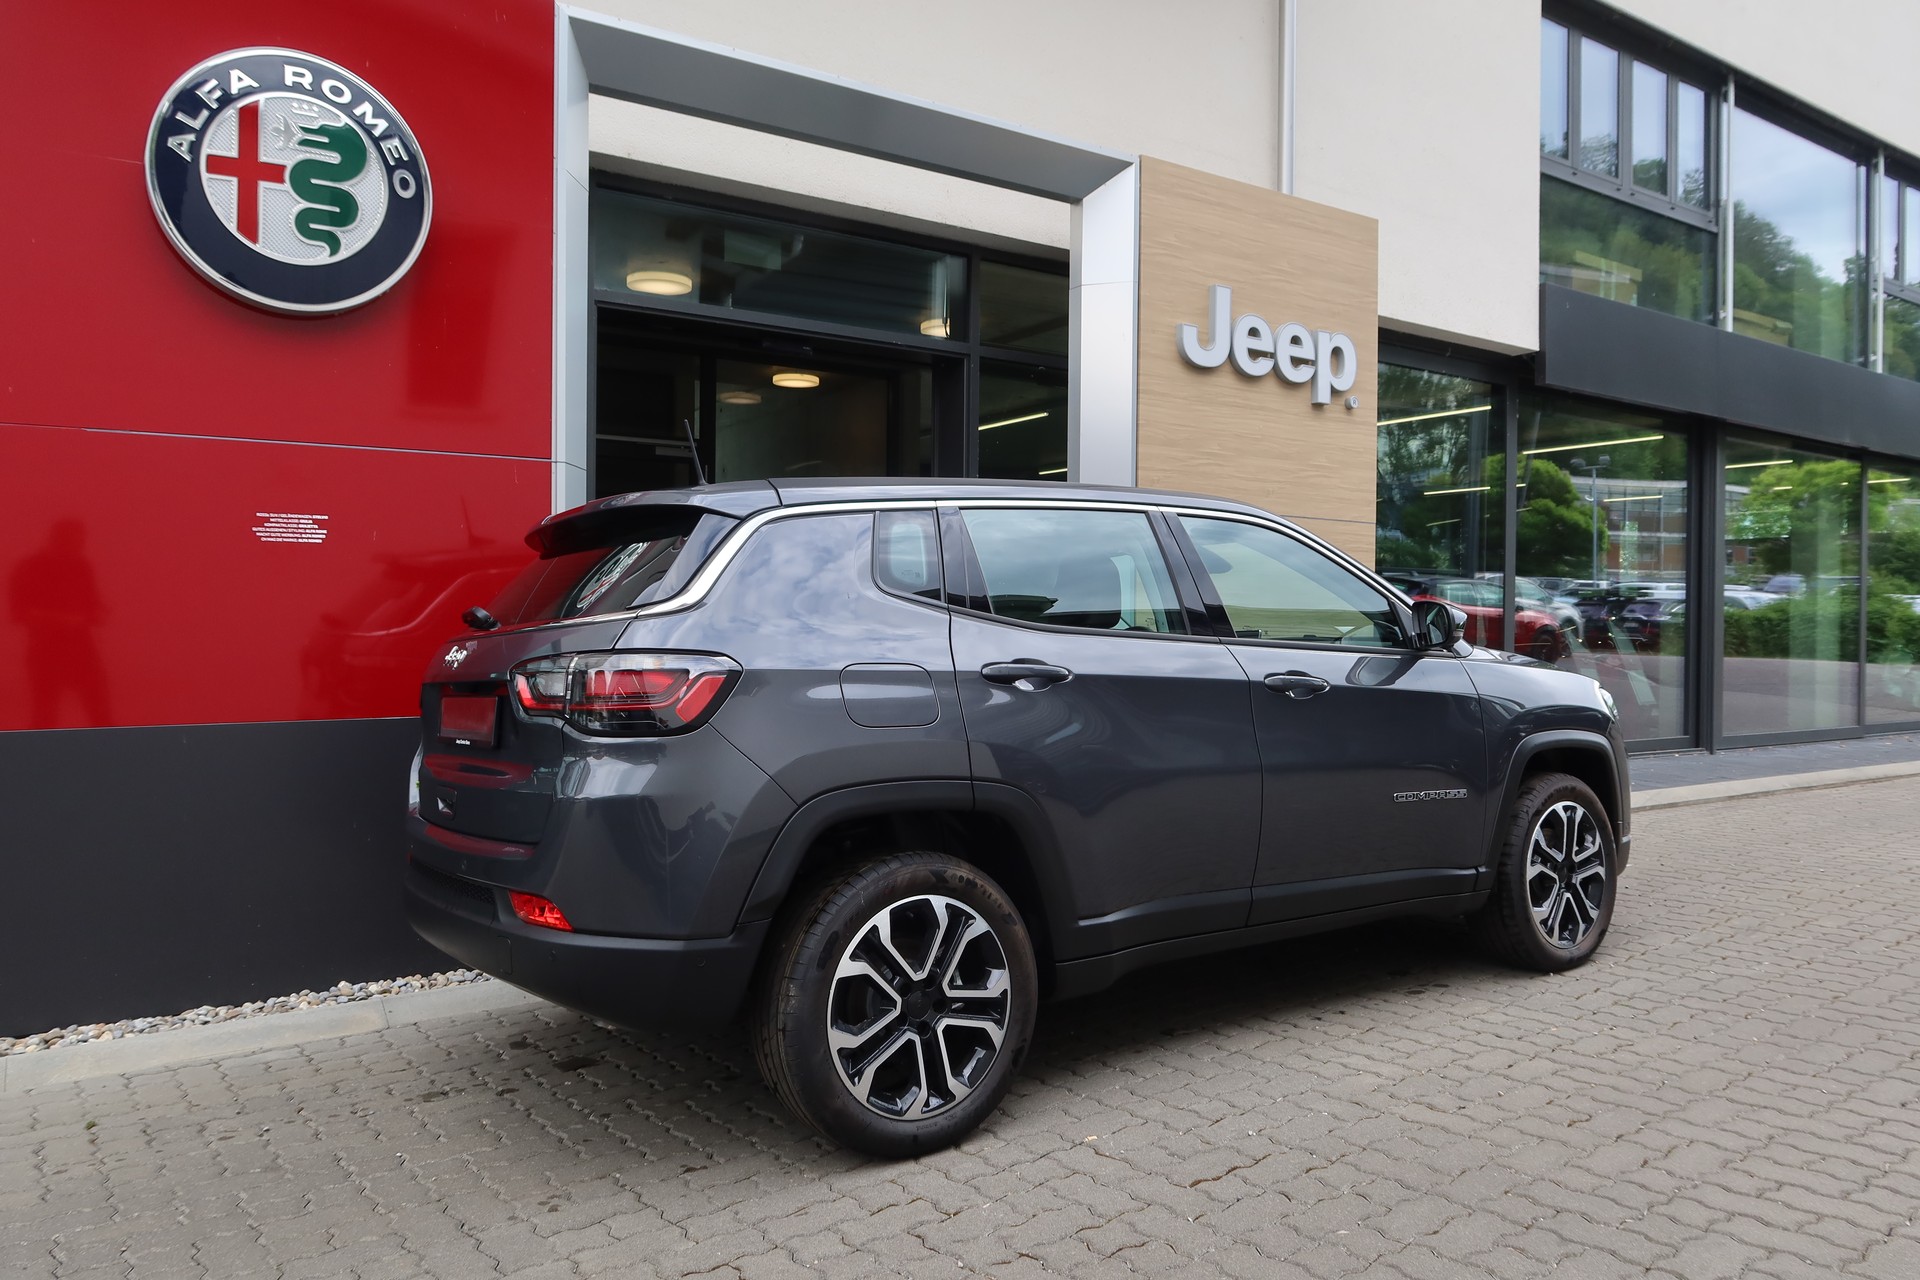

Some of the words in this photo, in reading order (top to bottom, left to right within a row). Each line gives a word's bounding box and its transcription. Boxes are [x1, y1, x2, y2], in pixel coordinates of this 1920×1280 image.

[166, 68, 260, 163] ALFA
[283, 64, 416, 200] ROMEO
[1176, 284, 1357, 405] Jeep
[1393, 788, 1468, 803] COMPASS
